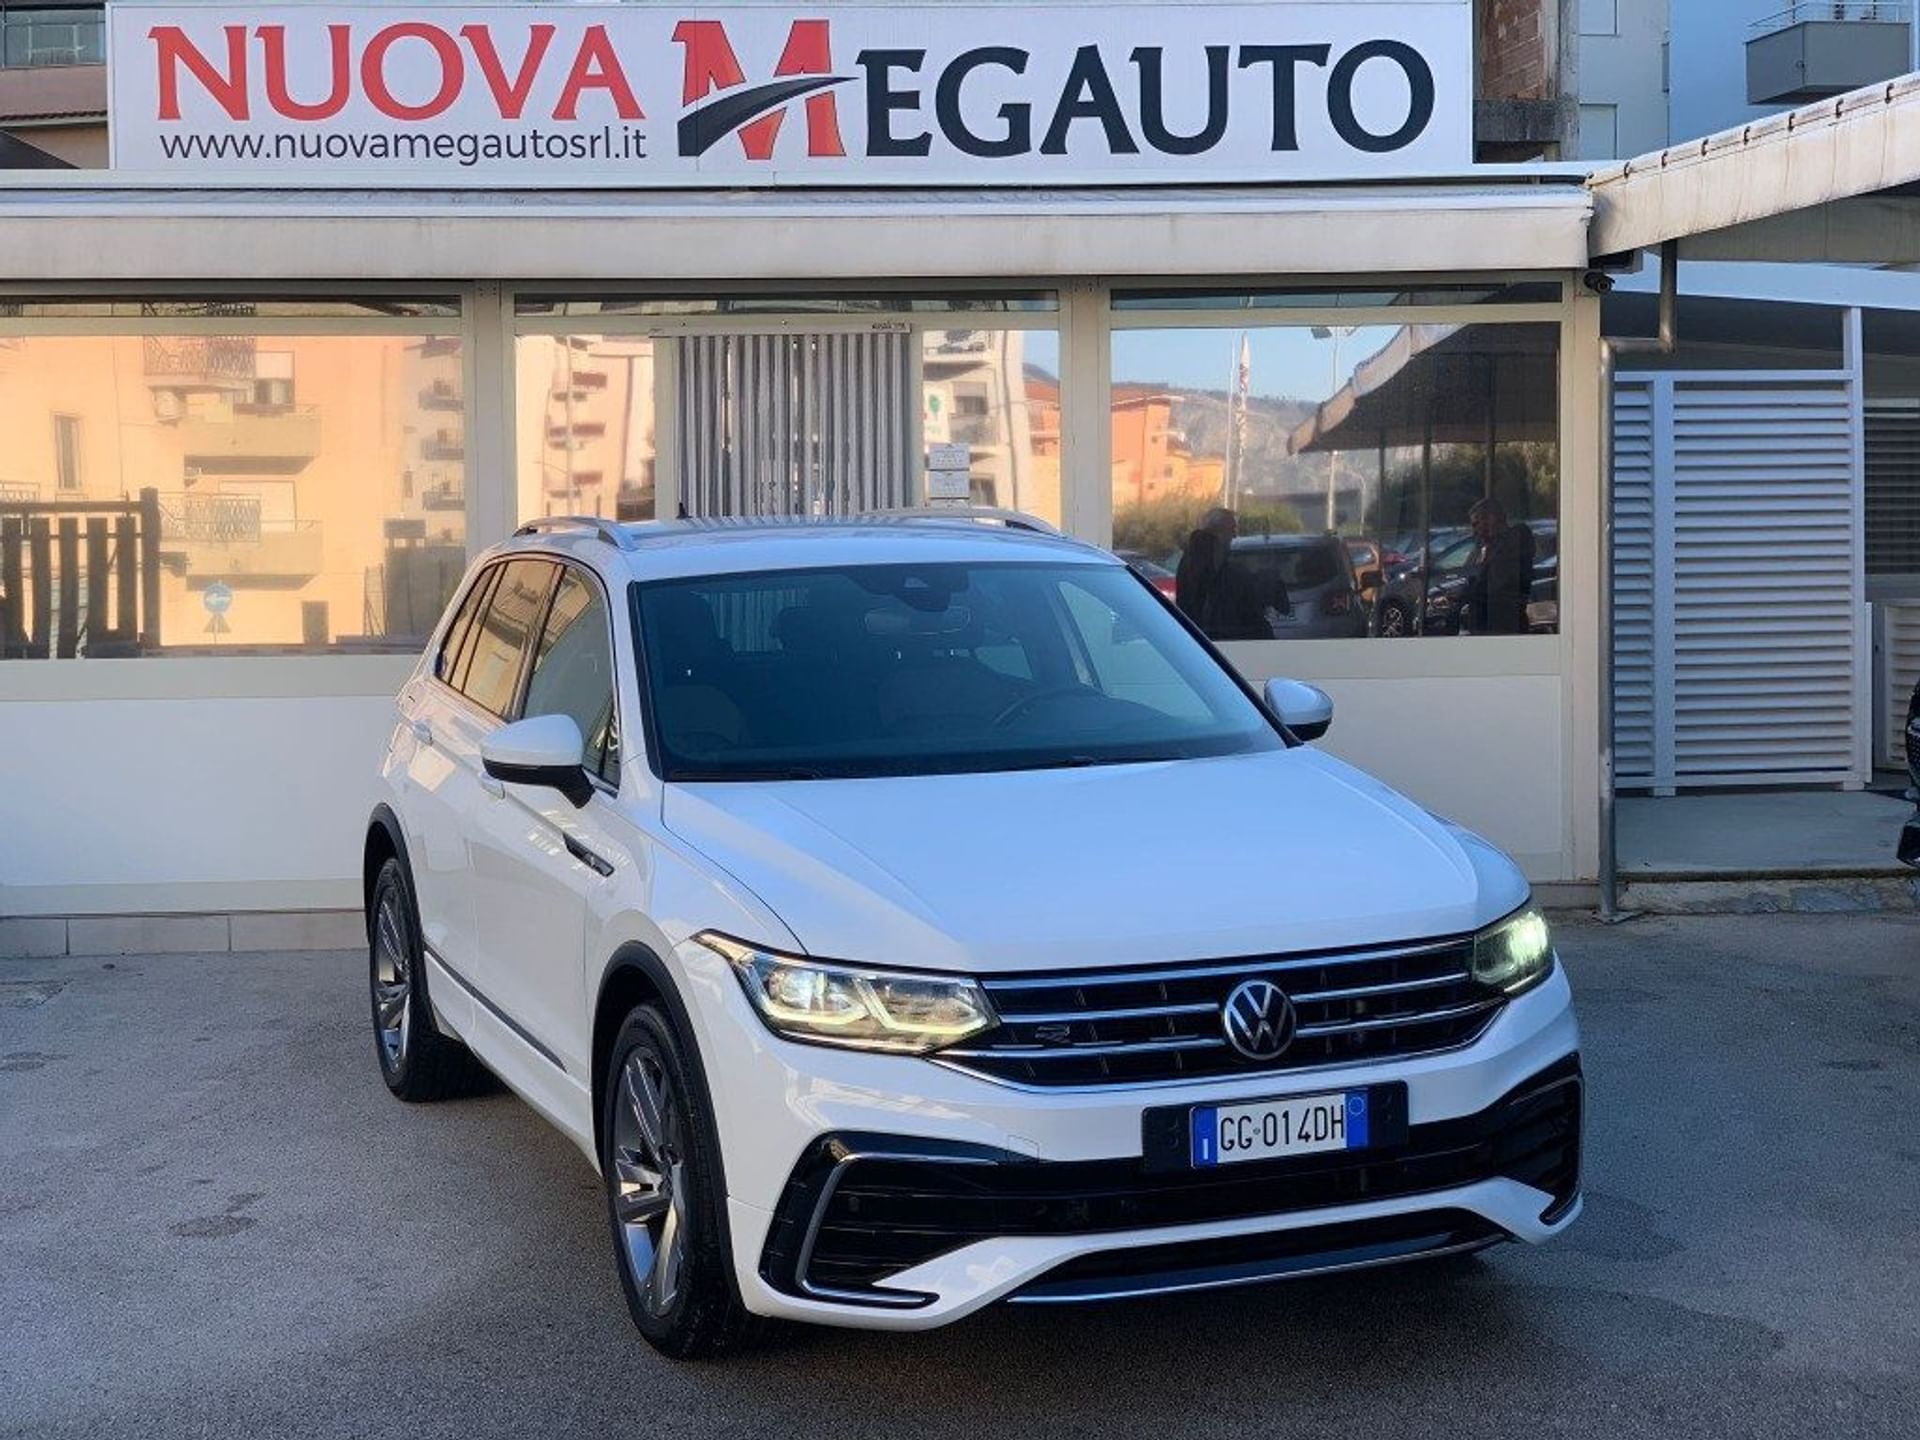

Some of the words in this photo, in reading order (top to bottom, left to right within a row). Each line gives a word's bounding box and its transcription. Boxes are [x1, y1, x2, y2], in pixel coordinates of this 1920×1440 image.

[149, 22, 646, 121] NUOVA
[672, 19, 1435, 159] MEGAUTO
[160, 126, 647, 166] www.nuovamegautosrl.it
